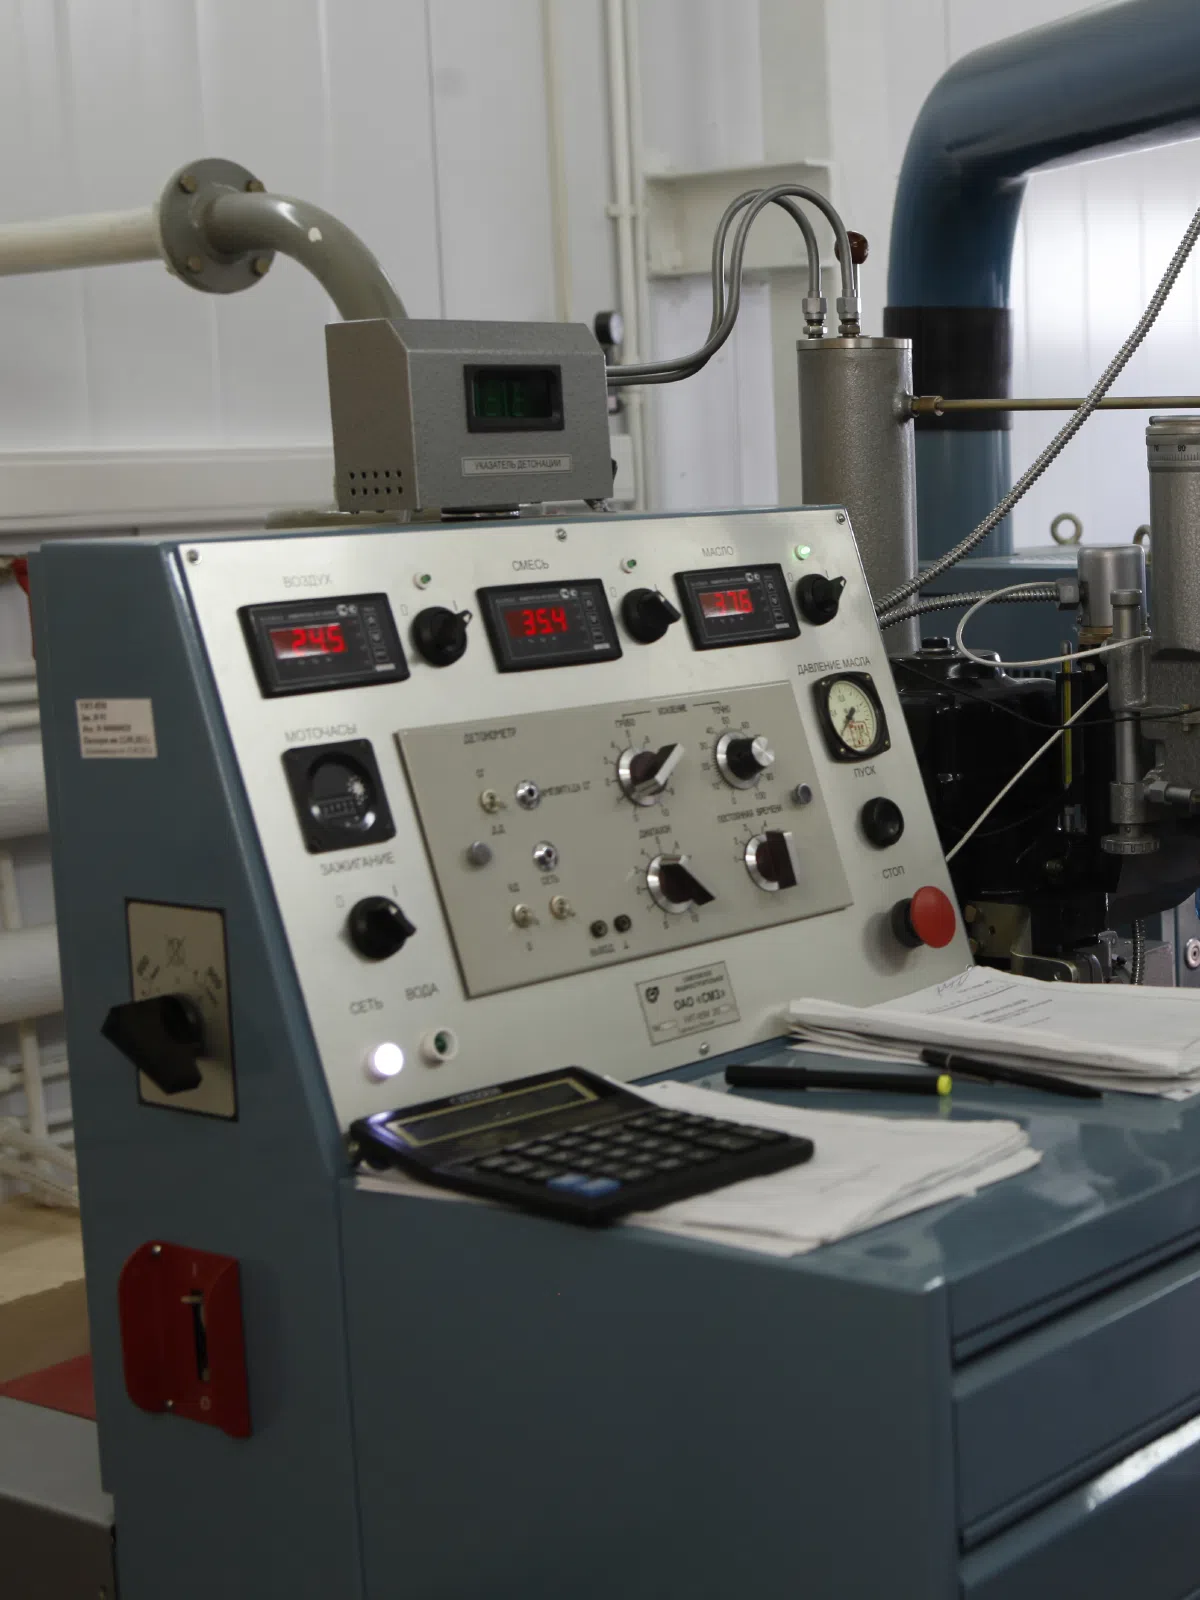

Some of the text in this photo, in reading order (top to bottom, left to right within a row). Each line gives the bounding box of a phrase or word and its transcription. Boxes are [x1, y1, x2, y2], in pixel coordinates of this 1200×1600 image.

[473, 458, 562, 471] УКАЗАТЕЛЬ ДЕТОНАЦИИ
[701, 545, 734, 558] МАСЛО
[511, 558, 550, 572] СМЕСЬ
[282, 572, 333, 588] ВОЗДУХ
[797, 656, 872, 676] ДАВЛЕНИЕ МАСЛА
[284, 724, 358, 743] МОТОЧАСЫ
[854, 765, 877, 779] ПУСК
[320, 852, 396, 876] ЗАЖИГАНИЕ
[882, 865, 906, 880] СТОП
[404, 982, 439, 1001] ВОДА
[349, 997, 384, 1015] СЕТЬ
